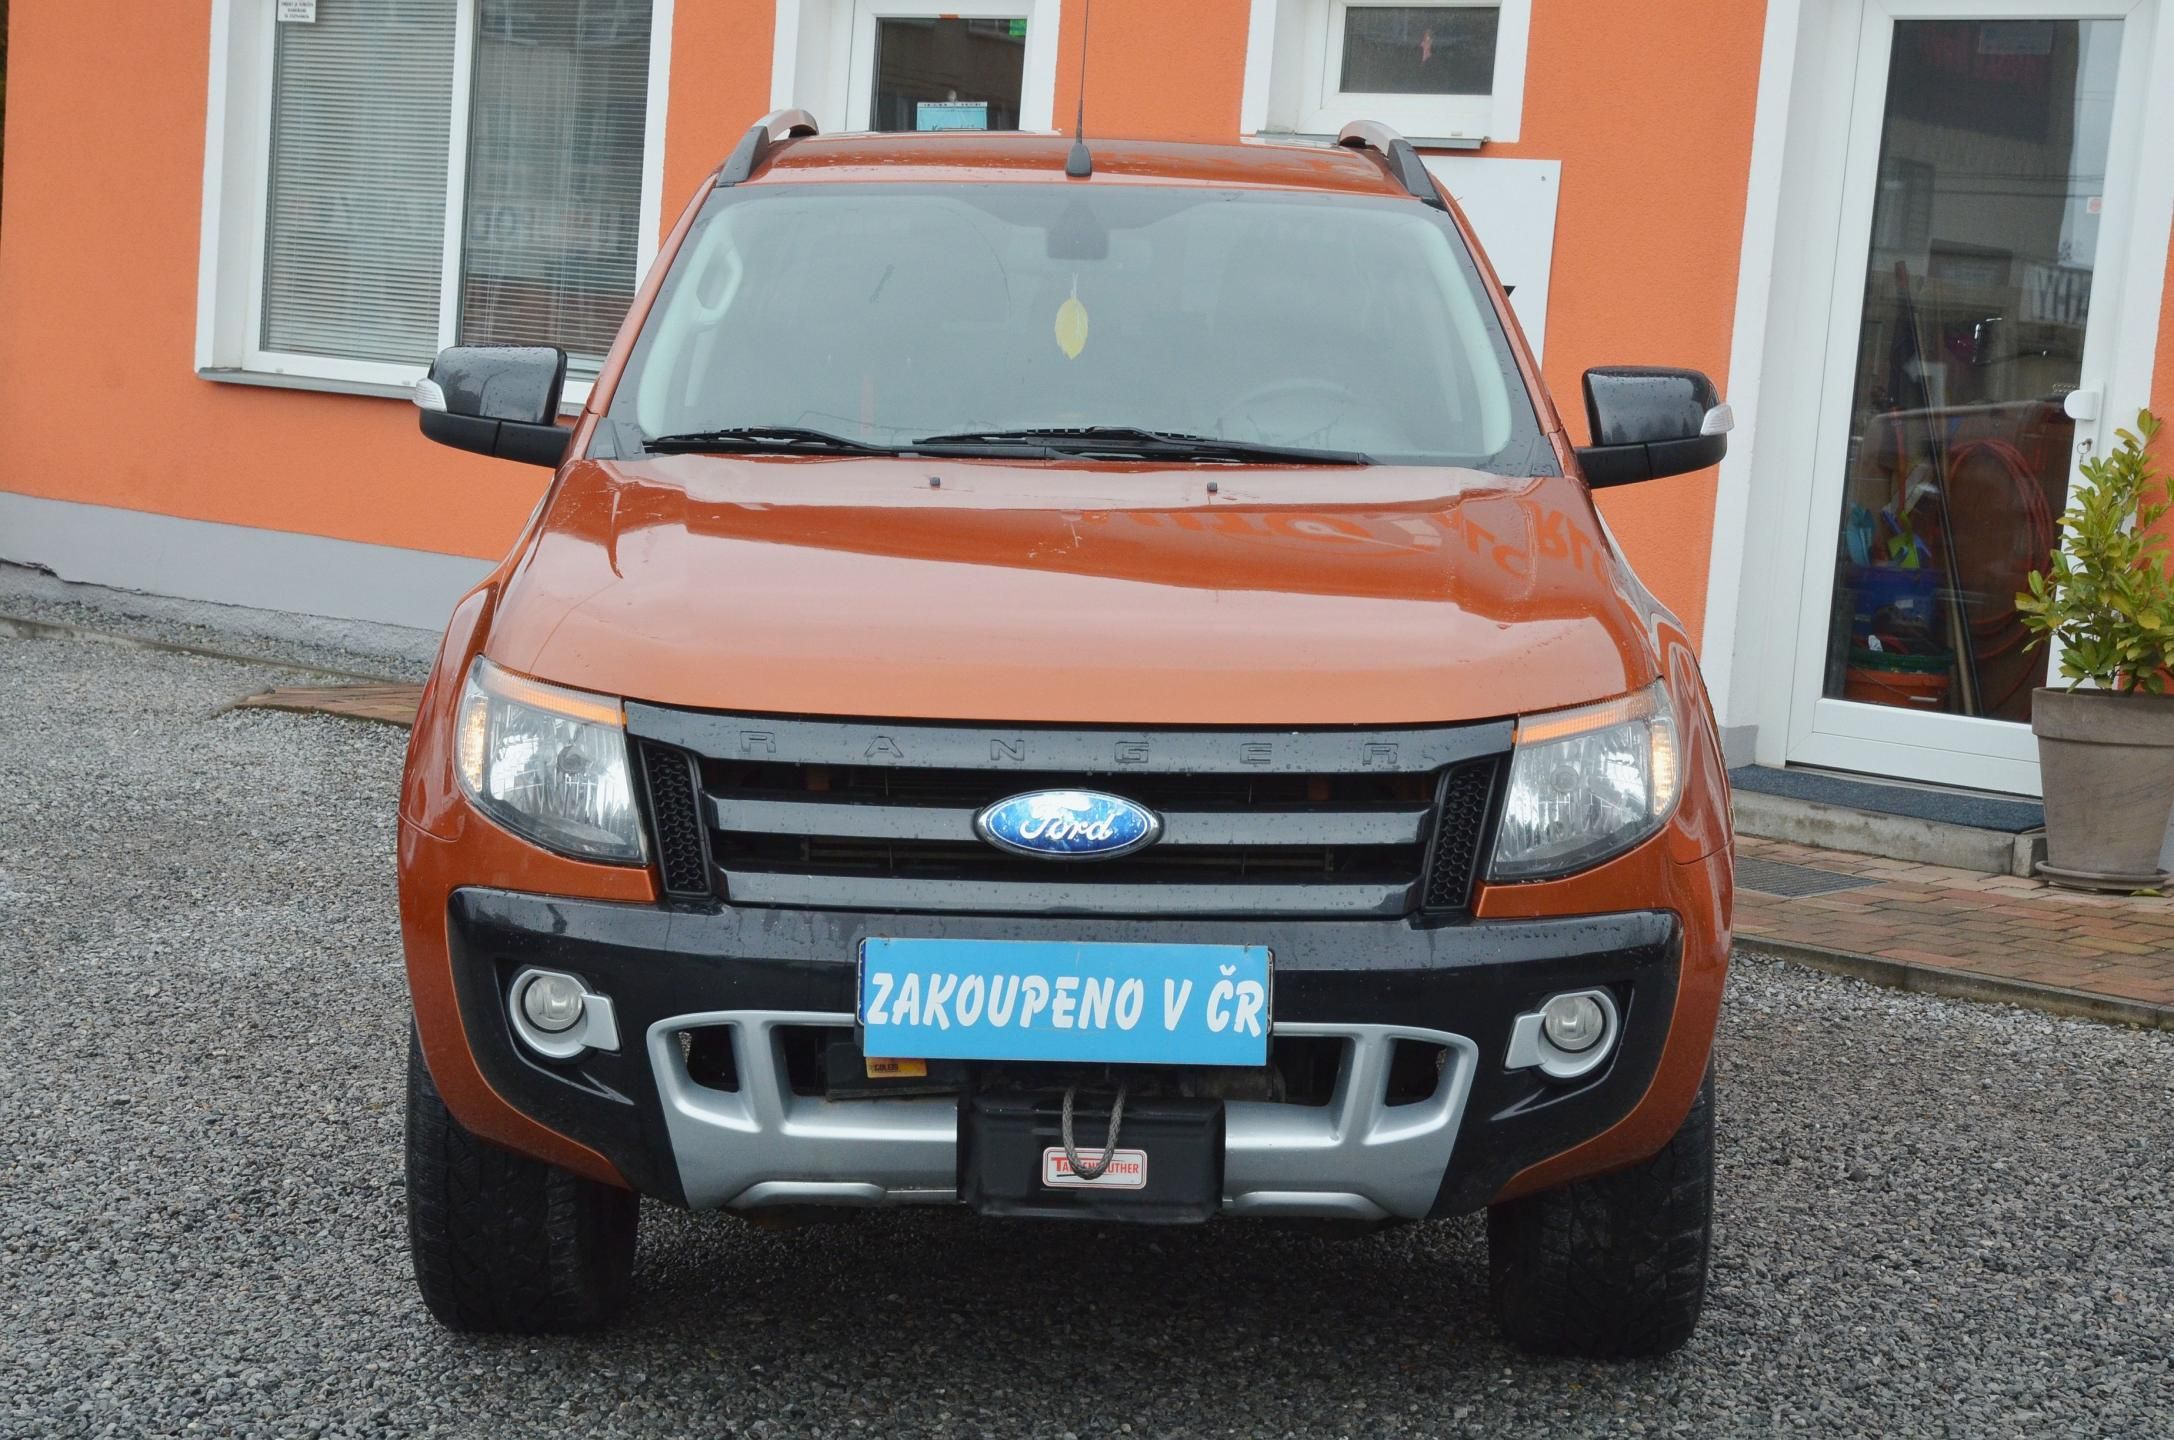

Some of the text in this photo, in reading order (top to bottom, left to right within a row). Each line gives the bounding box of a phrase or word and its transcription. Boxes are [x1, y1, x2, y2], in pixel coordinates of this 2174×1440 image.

[740, 730, 1399, 765] RANGER
[1020, 804, 1117, 841] Ford
[866, 964, 1265, 1037] ZAKOUPENO V ČR
